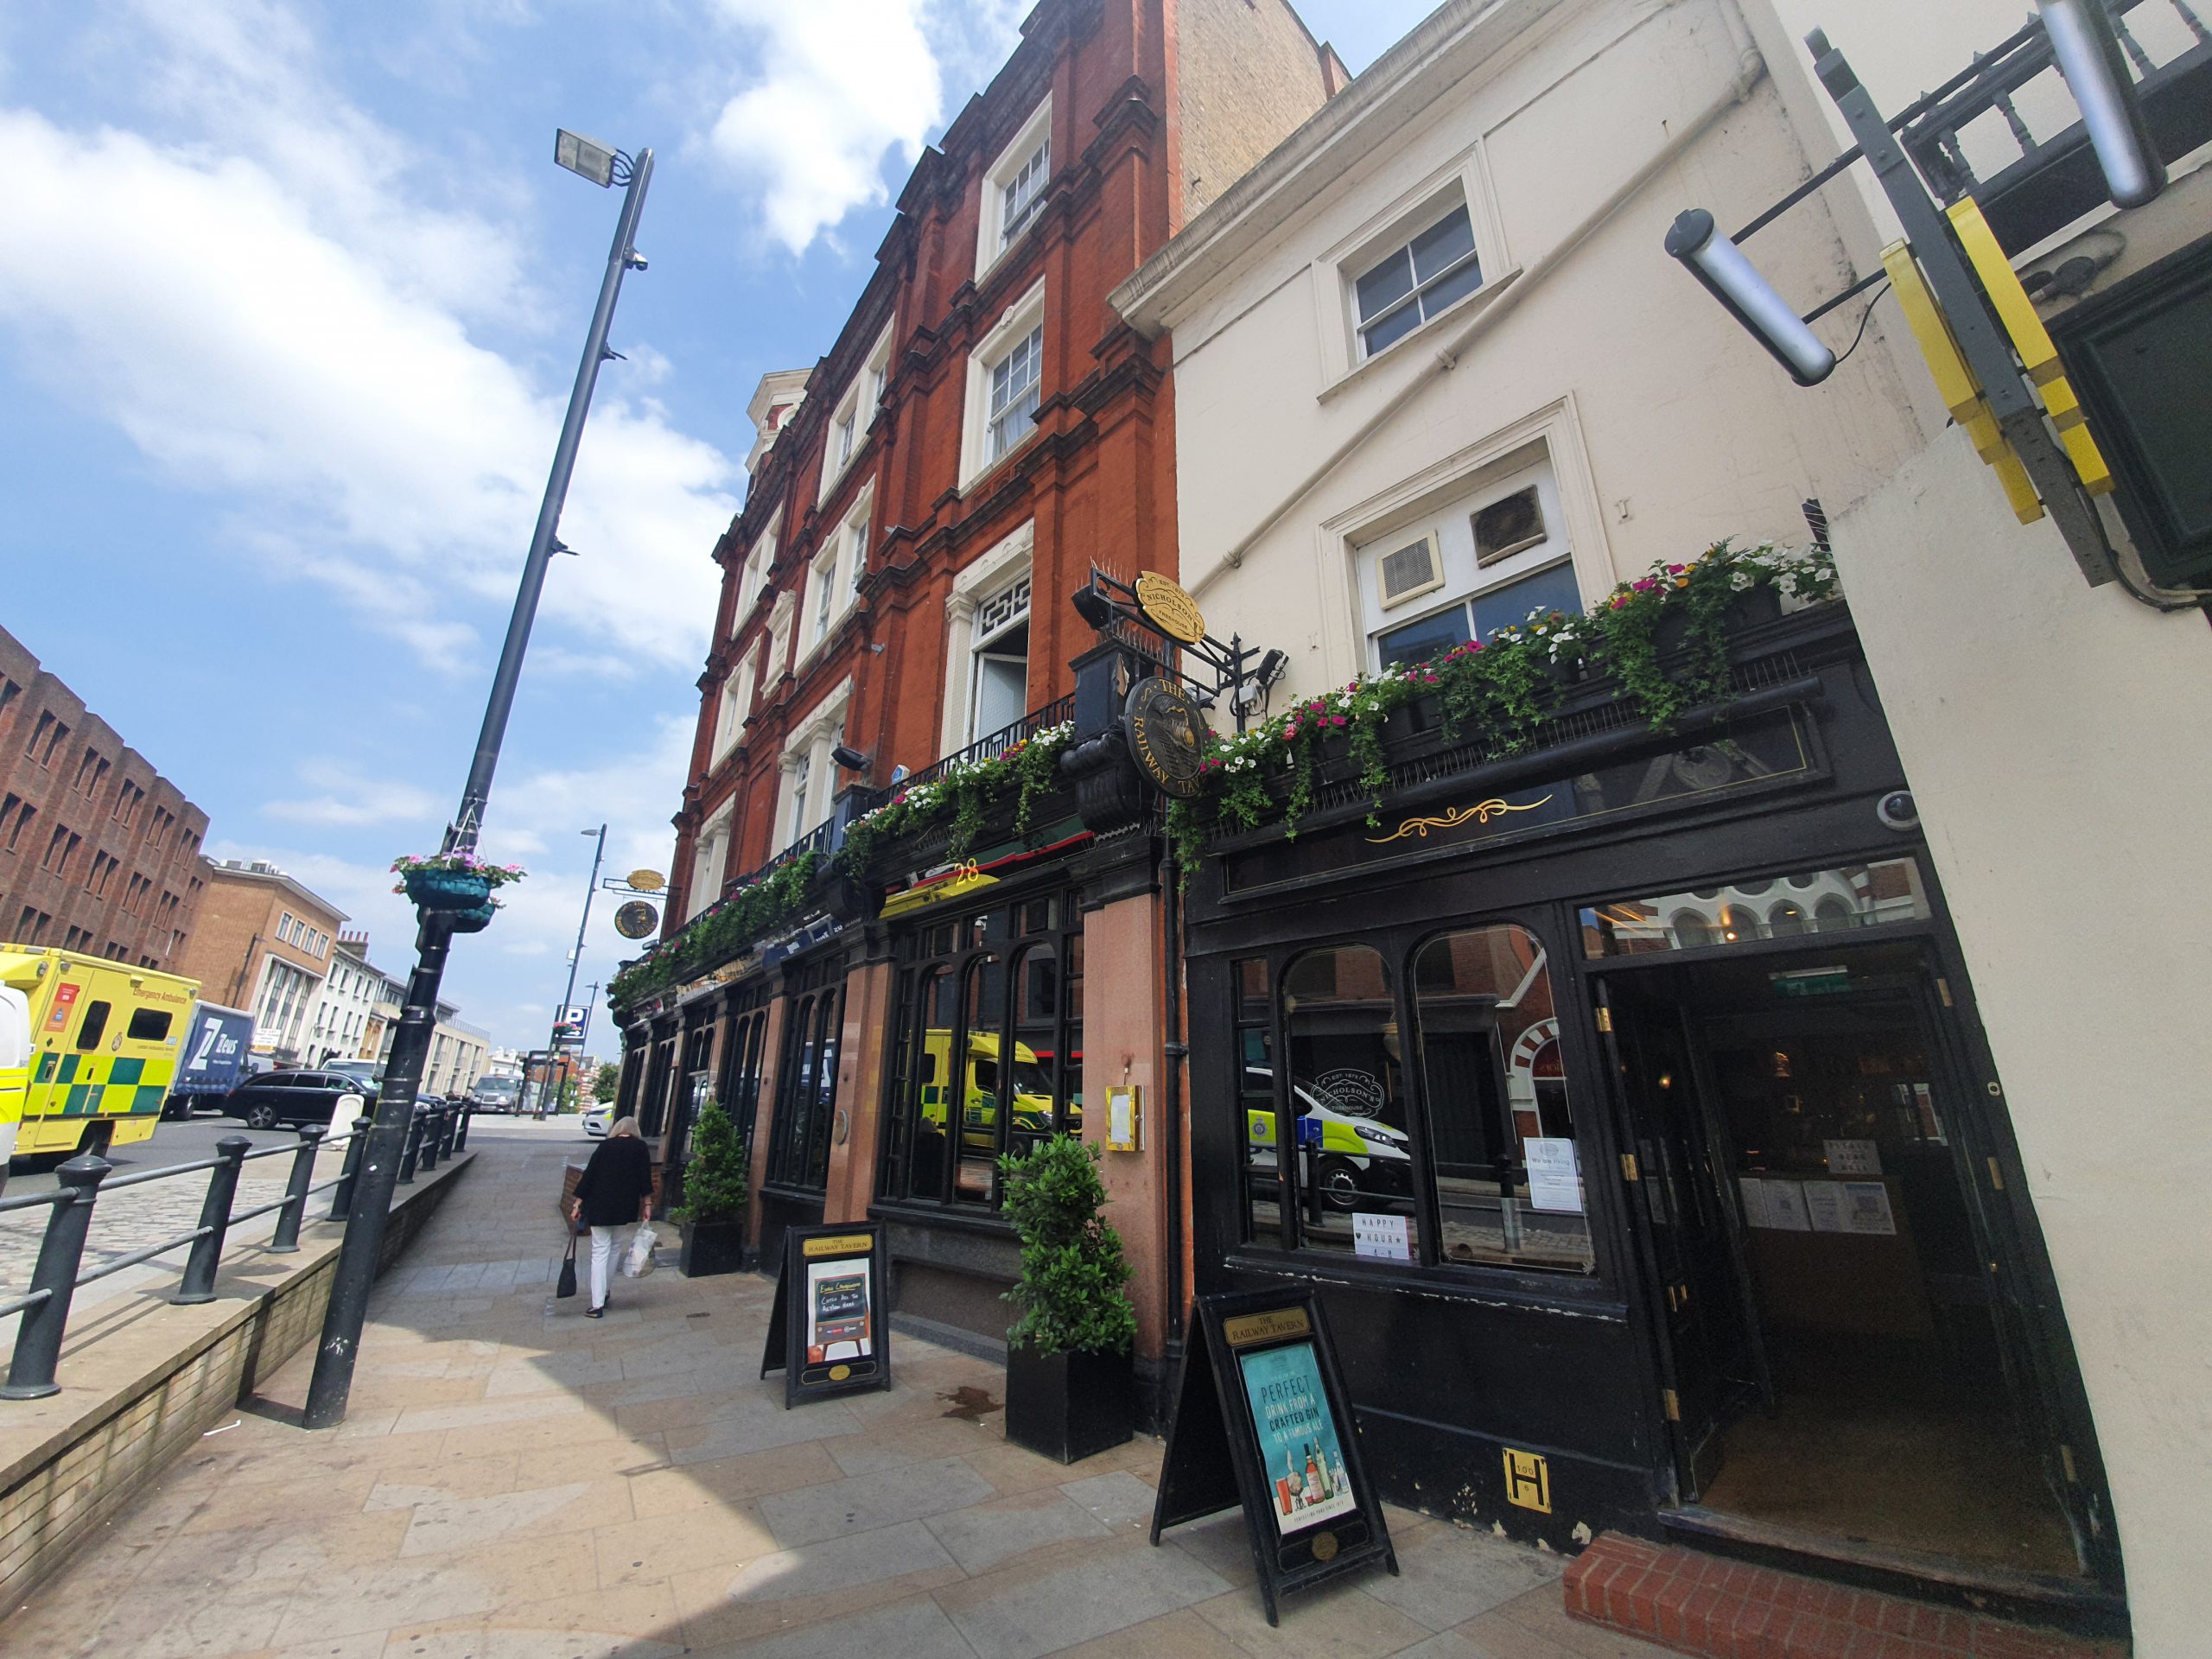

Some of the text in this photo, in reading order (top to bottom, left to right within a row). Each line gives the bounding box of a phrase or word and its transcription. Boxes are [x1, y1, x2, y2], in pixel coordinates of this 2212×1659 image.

[1159, 610, 1188, 630] FREEHOUSE
[1159, 679, 1185, 701] THE
[1134, 715, 1169, 784] RAILWAY
[955, 857, 978, 887] 28
[133, 988, 188, 1004] Emergency Ambulance
[565, 1008, 584, 1025] P
[216, 1033, 238, 1054] Zeus
[1320, 1087, 1375, 1104] NICHOLSON'S
[1362, 1218, 1394, 1228] HAPPY
[1367, 1233, 1393, 1243] HOUR
[1232, 1320, 1305, 1340] RAILWAY TAVERN
[1259, 1316, 1273, 1325] THE
[1261, 1376, 1311, 1403] PERFECT
[1265, 1393, 1316, 1419] DRINK FROM A
[1269, 1407, 1319, 1432] CRAFTED GIN
[1273, 1433, 1283, 1443] TO
[1289, 1425, 1312, 1438] FAMOUS
[1313, 1419, 1324, 1431] ALE
[1509, 1452, 1544, 1506] H
[1517, 1465, 1534, 1475] 100
